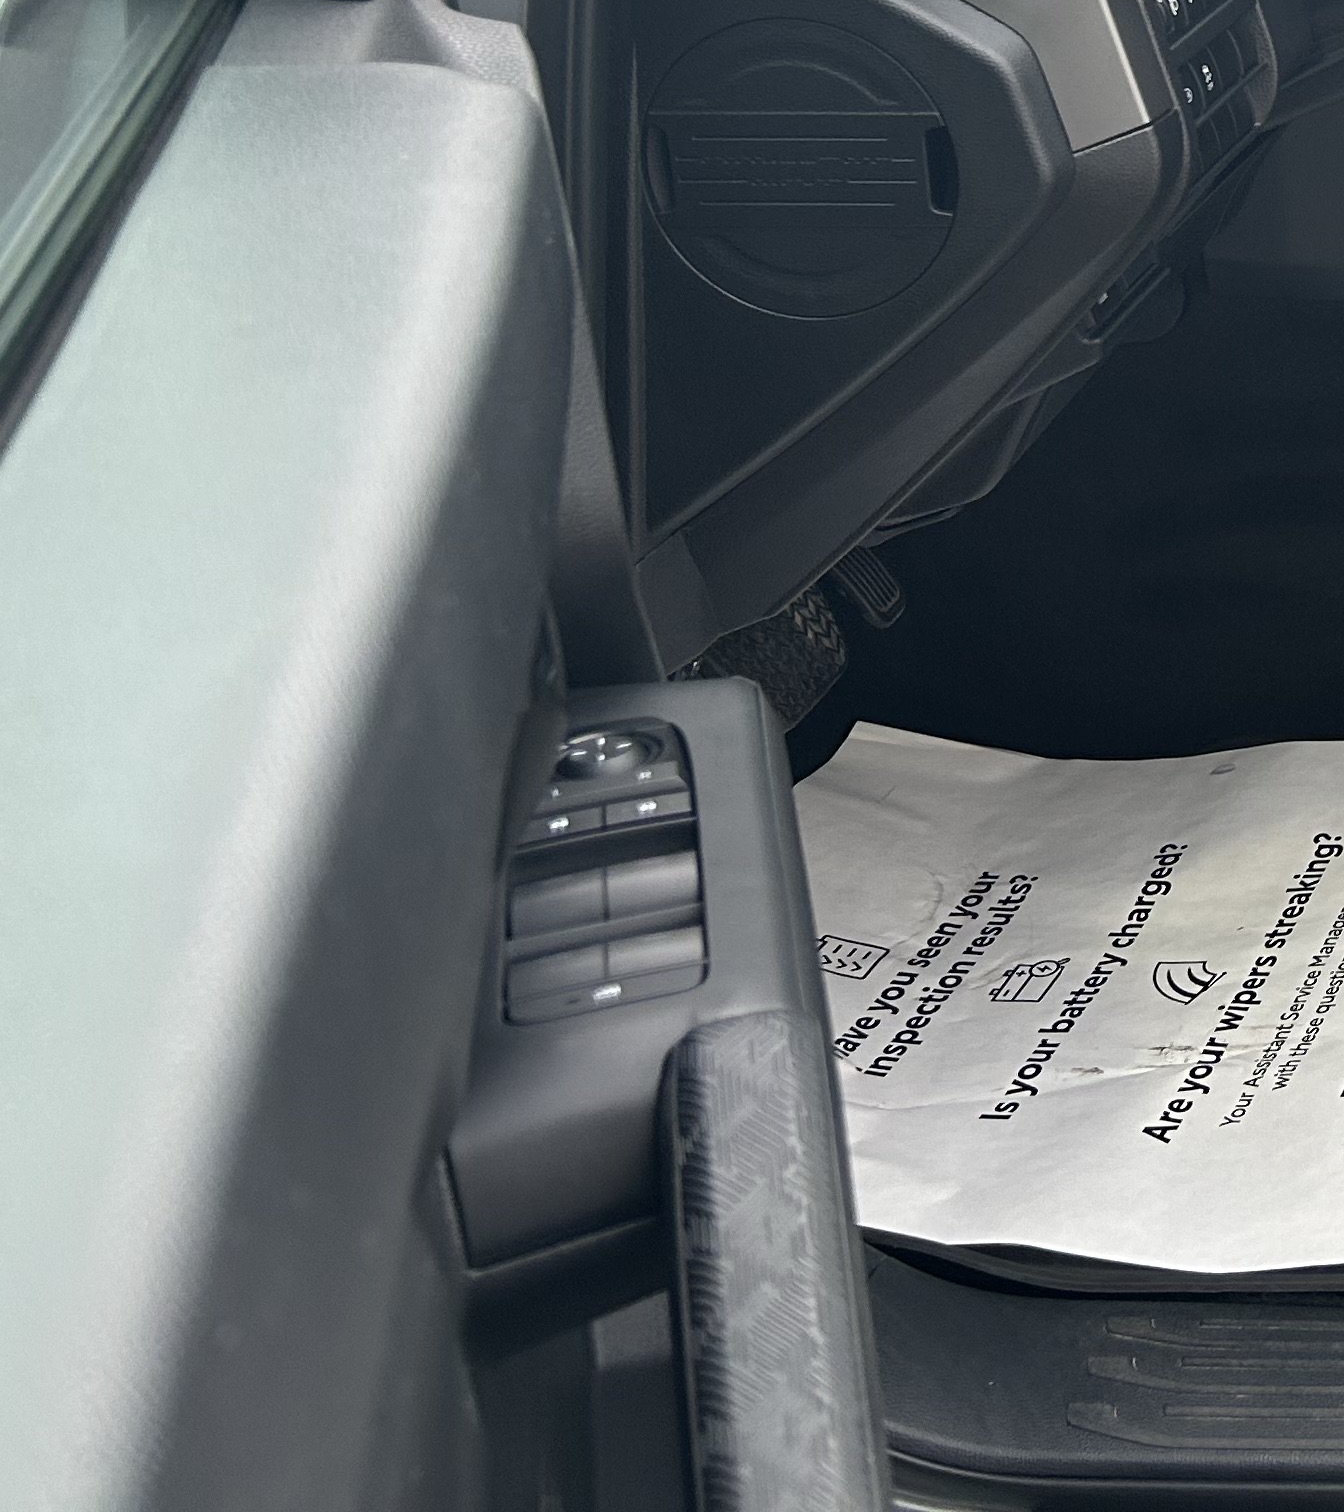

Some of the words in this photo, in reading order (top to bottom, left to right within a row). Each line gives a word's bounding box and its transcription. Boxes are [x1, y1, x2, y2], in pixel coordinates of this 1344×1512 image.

[856, 962, 976, 1077] inspection
[962, 875, 1038, 955] results?
[867, 972, 919, 1015] you
[907, 923, 963, 968] seen
[949, 872, 999, 919] your
[979, 1102, 1019, 1119] Is
[1005, 1039, 1060, 1096] your
[1038, 953, 1127, 1033] battery
[1108, 844, 1188, 948] charged?
[1142, 1099, 1193, 1143] Are
[1177, 1037, 1228, 1094] your
[1214, 956, 1277, 1032] wipers
[1265, 833, 1343, 948] streaking?
[1219, 1093, 1254, 1127] Your
[1243, 1024, 1294, 1087] Assistant
[1281, 971, 1321, 1020] Service
[1272, 1060, 1301, 1091] with
[1289, 1018, 1324, 1056] these
